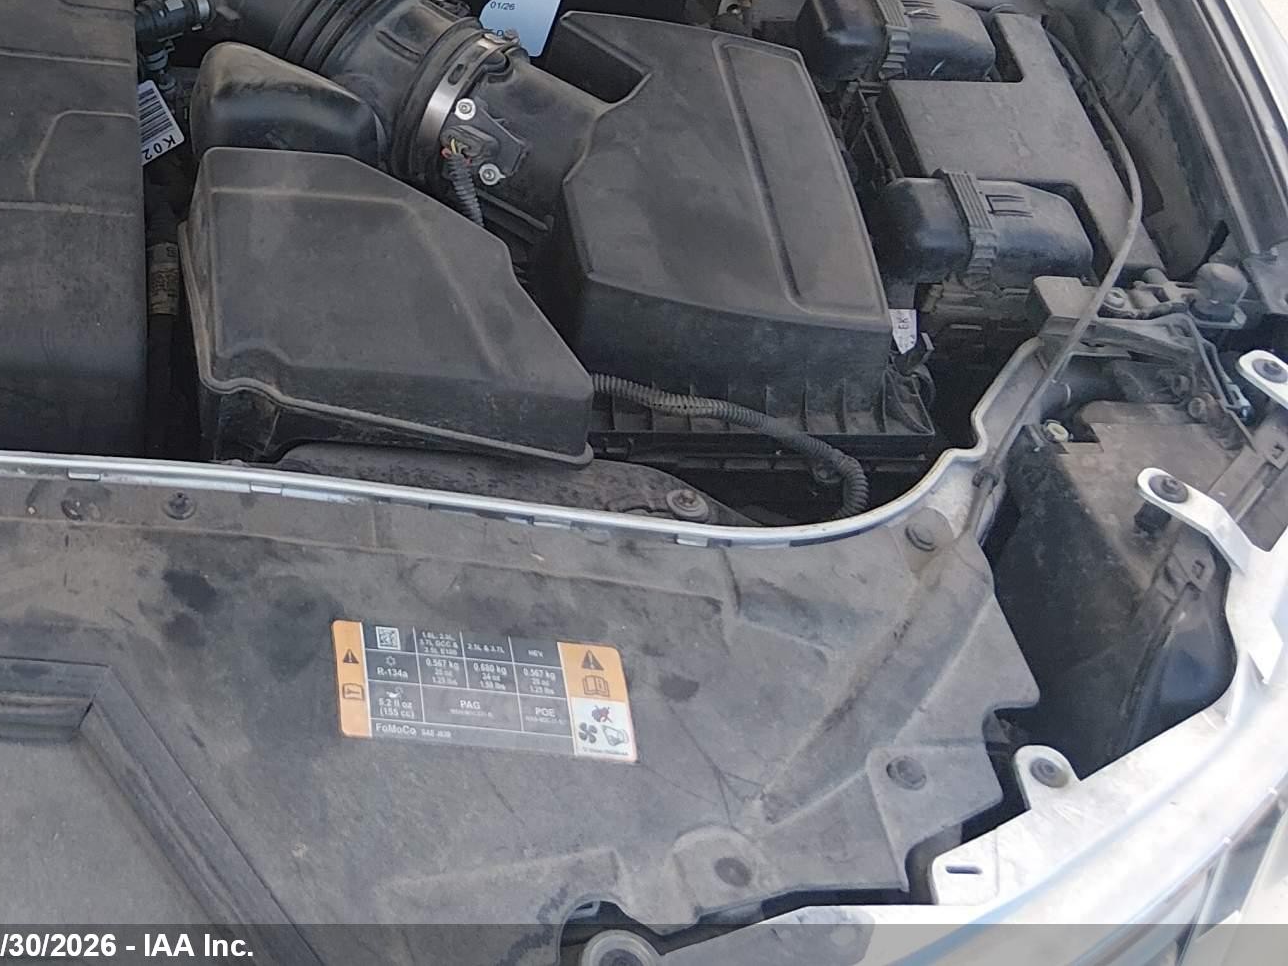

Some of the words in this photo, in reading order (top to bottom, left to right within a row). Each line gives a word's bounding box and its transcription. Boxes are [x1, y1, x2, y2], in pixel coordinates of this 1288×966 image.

[489, 1, 517, 11] 01/26
[376, 666, 409, 679] R-134a
[459, 699, 481, 710] PAG
[379, 706, 399, 717] (155
[375, 722, 417, 736] FoMoCo
